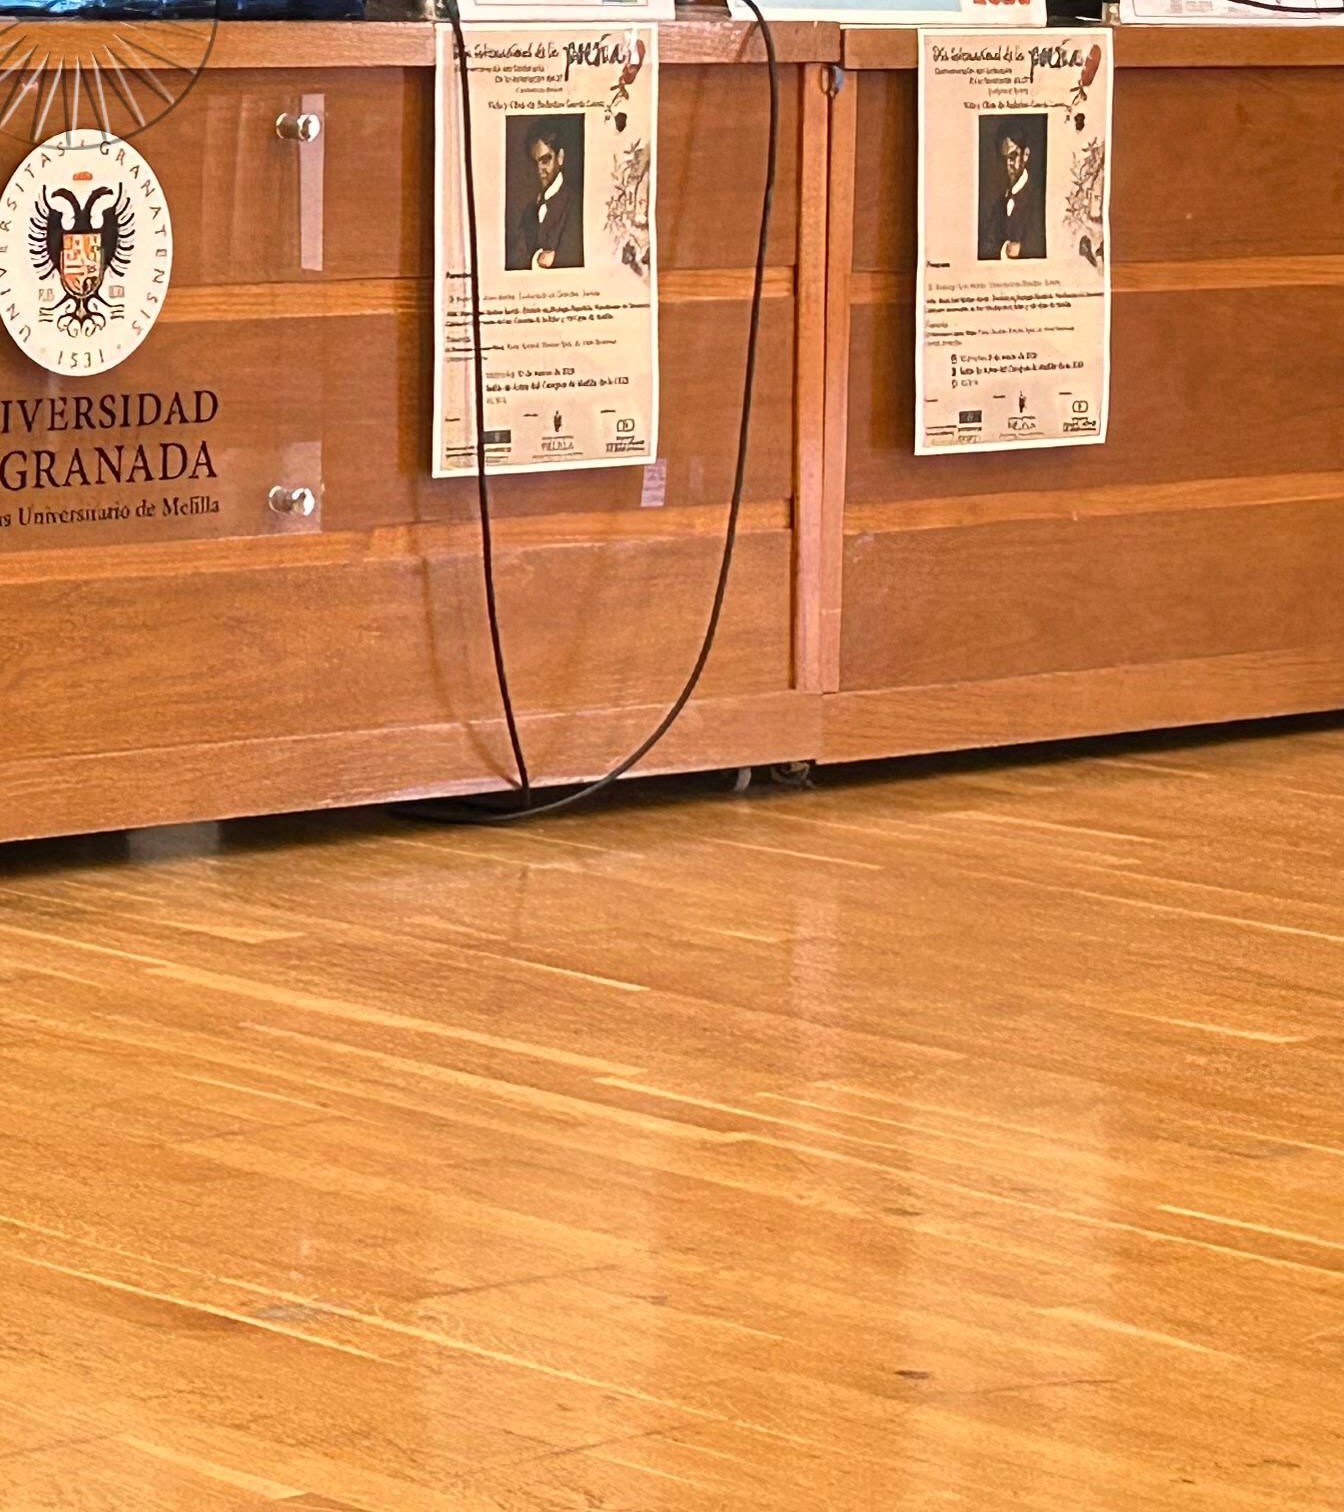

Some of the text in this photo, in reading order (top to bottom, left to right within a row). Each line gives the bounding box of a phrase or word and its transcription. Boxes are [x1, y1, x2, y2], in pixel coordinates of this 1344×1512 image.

[57, 348, 105, 369] 1531
[18, 504, 131, 527] Universitario
[135, 499, 156, 518] de
[162, 495, 220, 518] Melilla
